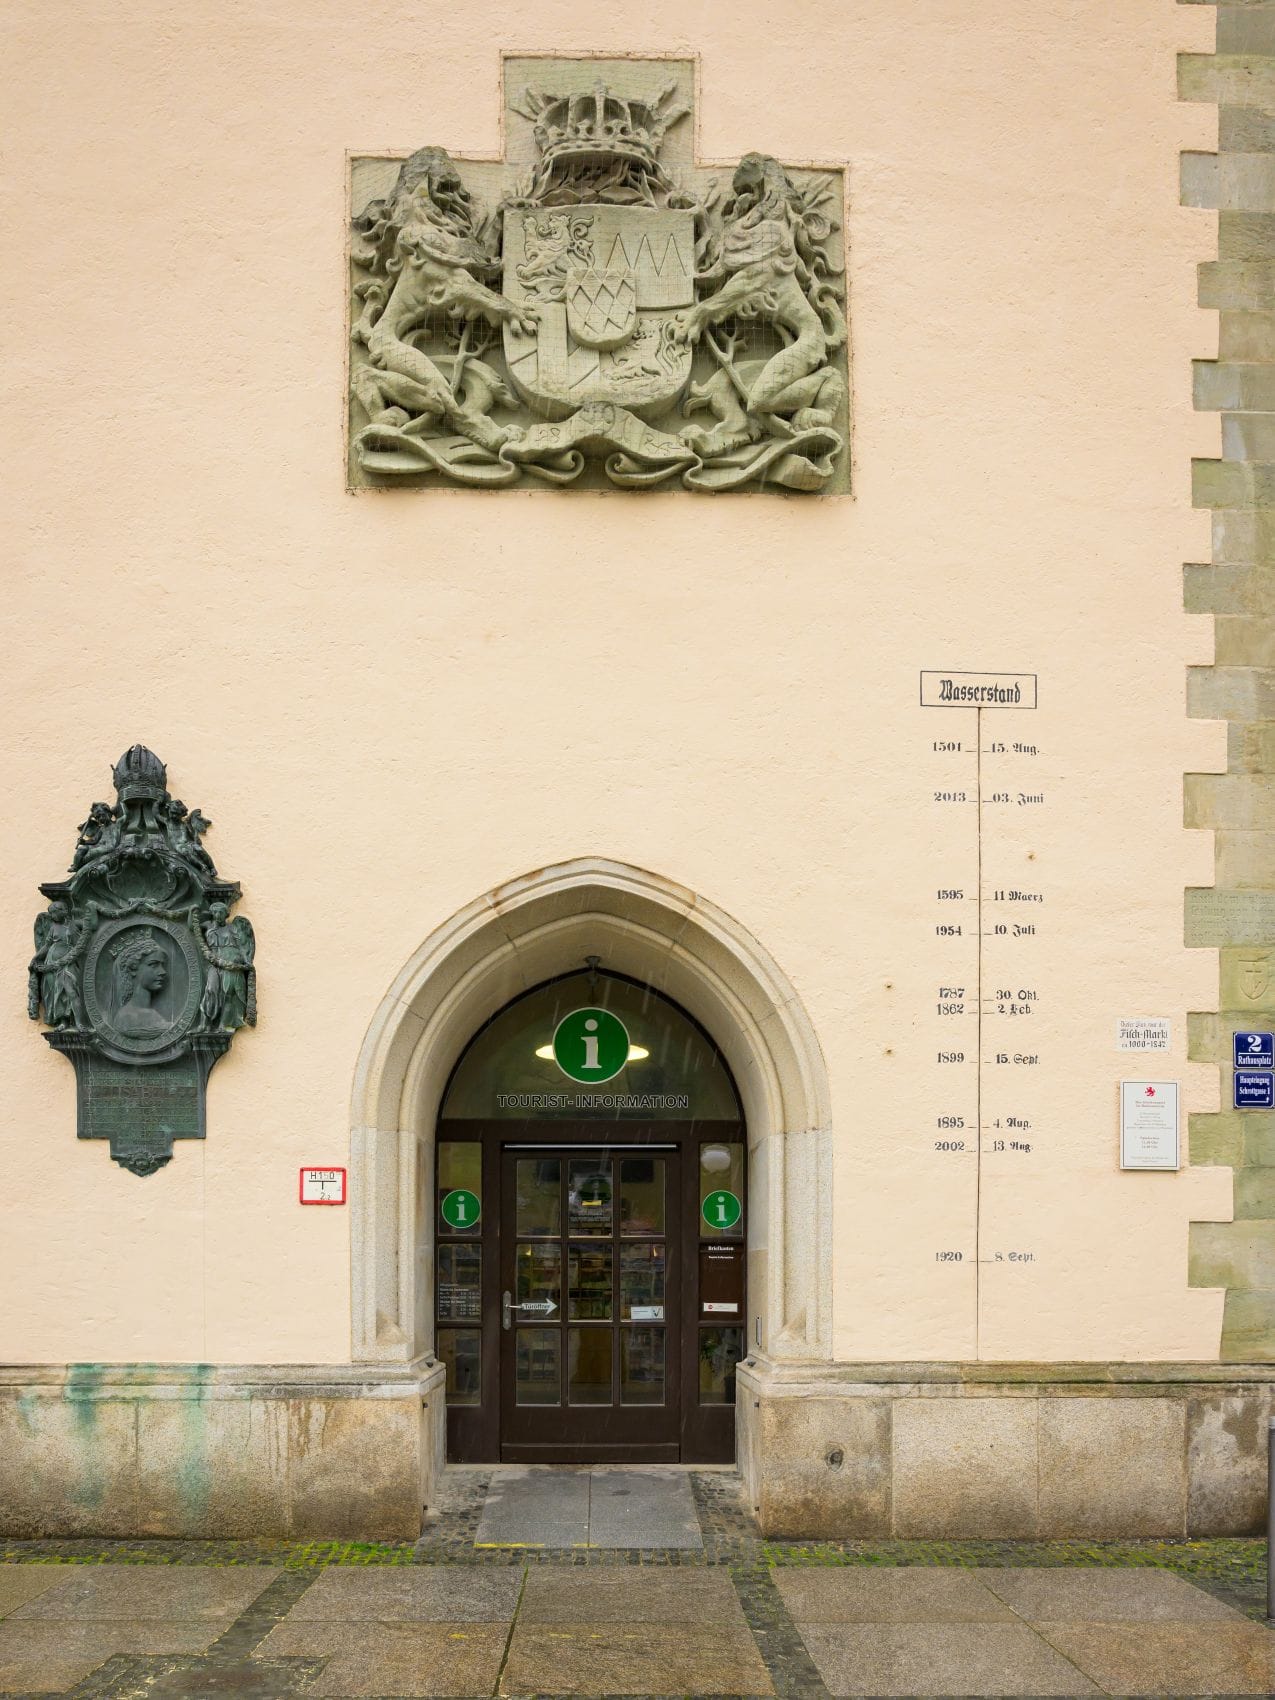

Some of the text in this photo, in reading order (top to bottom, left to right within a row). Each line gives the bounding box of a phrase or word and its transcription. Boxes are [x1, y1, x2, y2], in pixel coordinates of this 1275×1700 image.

[939, 680, 1021, 704] Wasserstand
[933, 742, 1040, 756] 1501 15. Aug.
[934, 791, 1044, 806] 2013 03. Juni
[937, 889, 964, 900] 1595
[936, 925, 962, 936] 1954
[1012, 924, 1036, 937] Juli
[939, 988, 965, 998] 1787
[996, 990, 1013, 1000] 30.
[936, 1003, 964, 1015] 1862
[1247, 1034, 1262, 1052] 2
[937, 1052, 965, 1063] 1899
[996, 1054, 1011, 1064] 15.
[1238, 1055, 1272, 1067] Rathausplatz
[496, 1094, 689, 1109] TOURIST-INFORMATION
[937, 1117, 964, 1128] 1895
[934, 1141, 965, 1151] 2002
[936, 1252, 963, 1262] 1920
